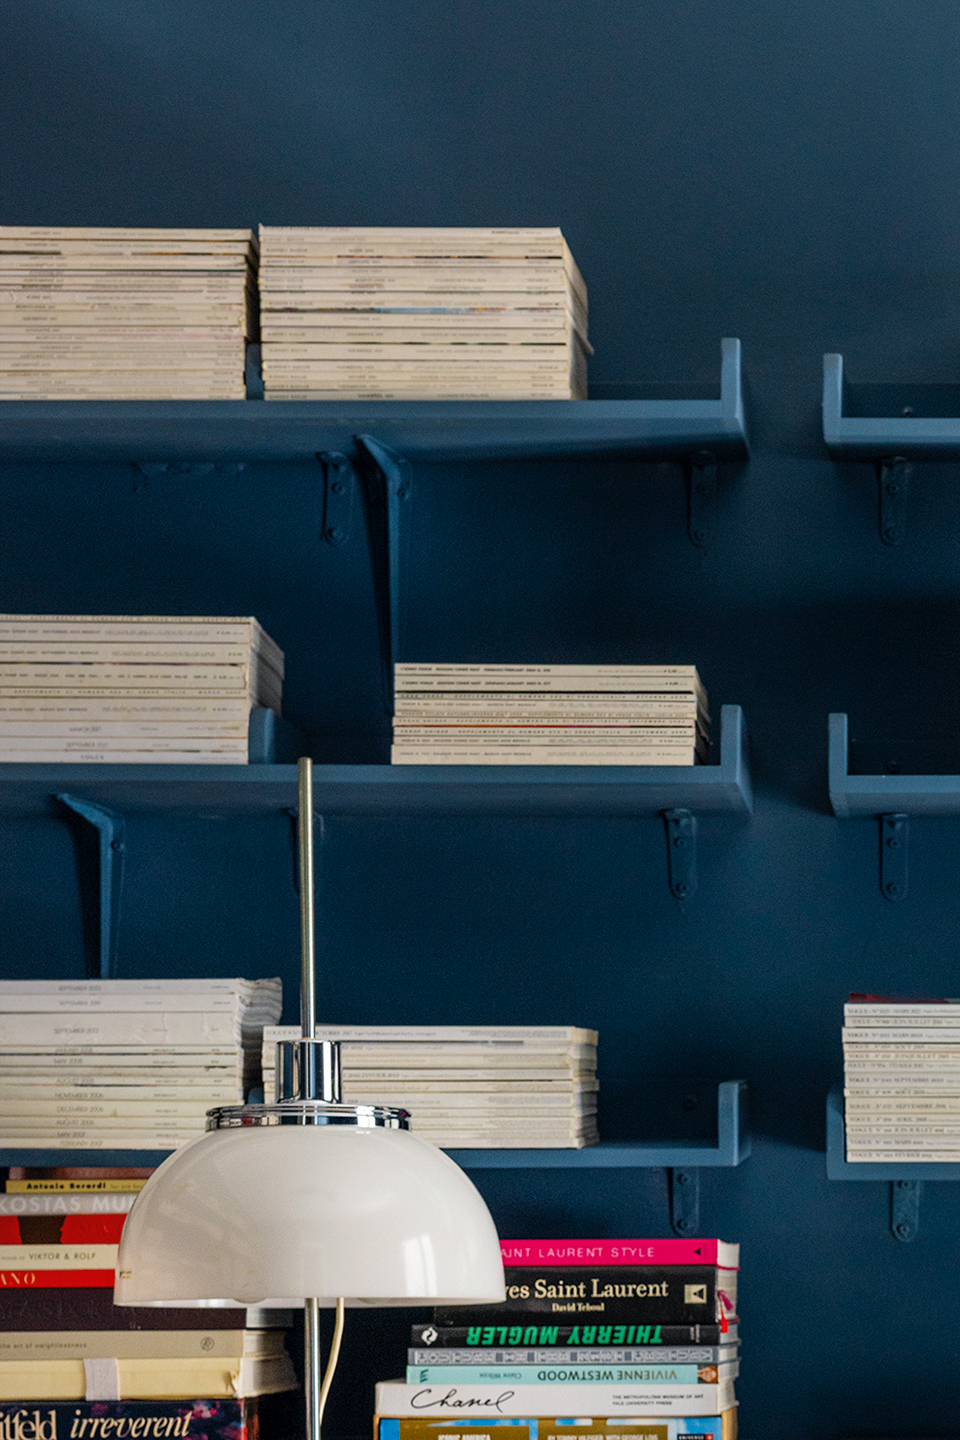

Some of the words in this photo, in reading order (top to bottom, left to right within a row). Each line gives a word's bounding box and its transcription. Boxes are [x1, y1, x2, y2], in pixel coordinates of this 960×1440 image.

[29, 1252, 60, 1260] VIKTOR
[64, 1252, 70, 1260] &
[538, 1247, 603, 1258] LAURENT
[610, 1247, 654, 1257] STYLE
[534, 1279, 586, 1298] Saint
[591, 1278, 668, 1298] Laurent
[552, 1303, 575, 1311] David
[466, 1326, 559, 1345] MUGLER
[566, 1325, 662, 1344] THIERRY
[538, 1370, 614, 1381] WESTWOOD
[617, 1369, 678, 1380] VIVIENNE
[410, 1388, 515, 1413] Chanel
[70, 1409, 192, 1439] irreverent
